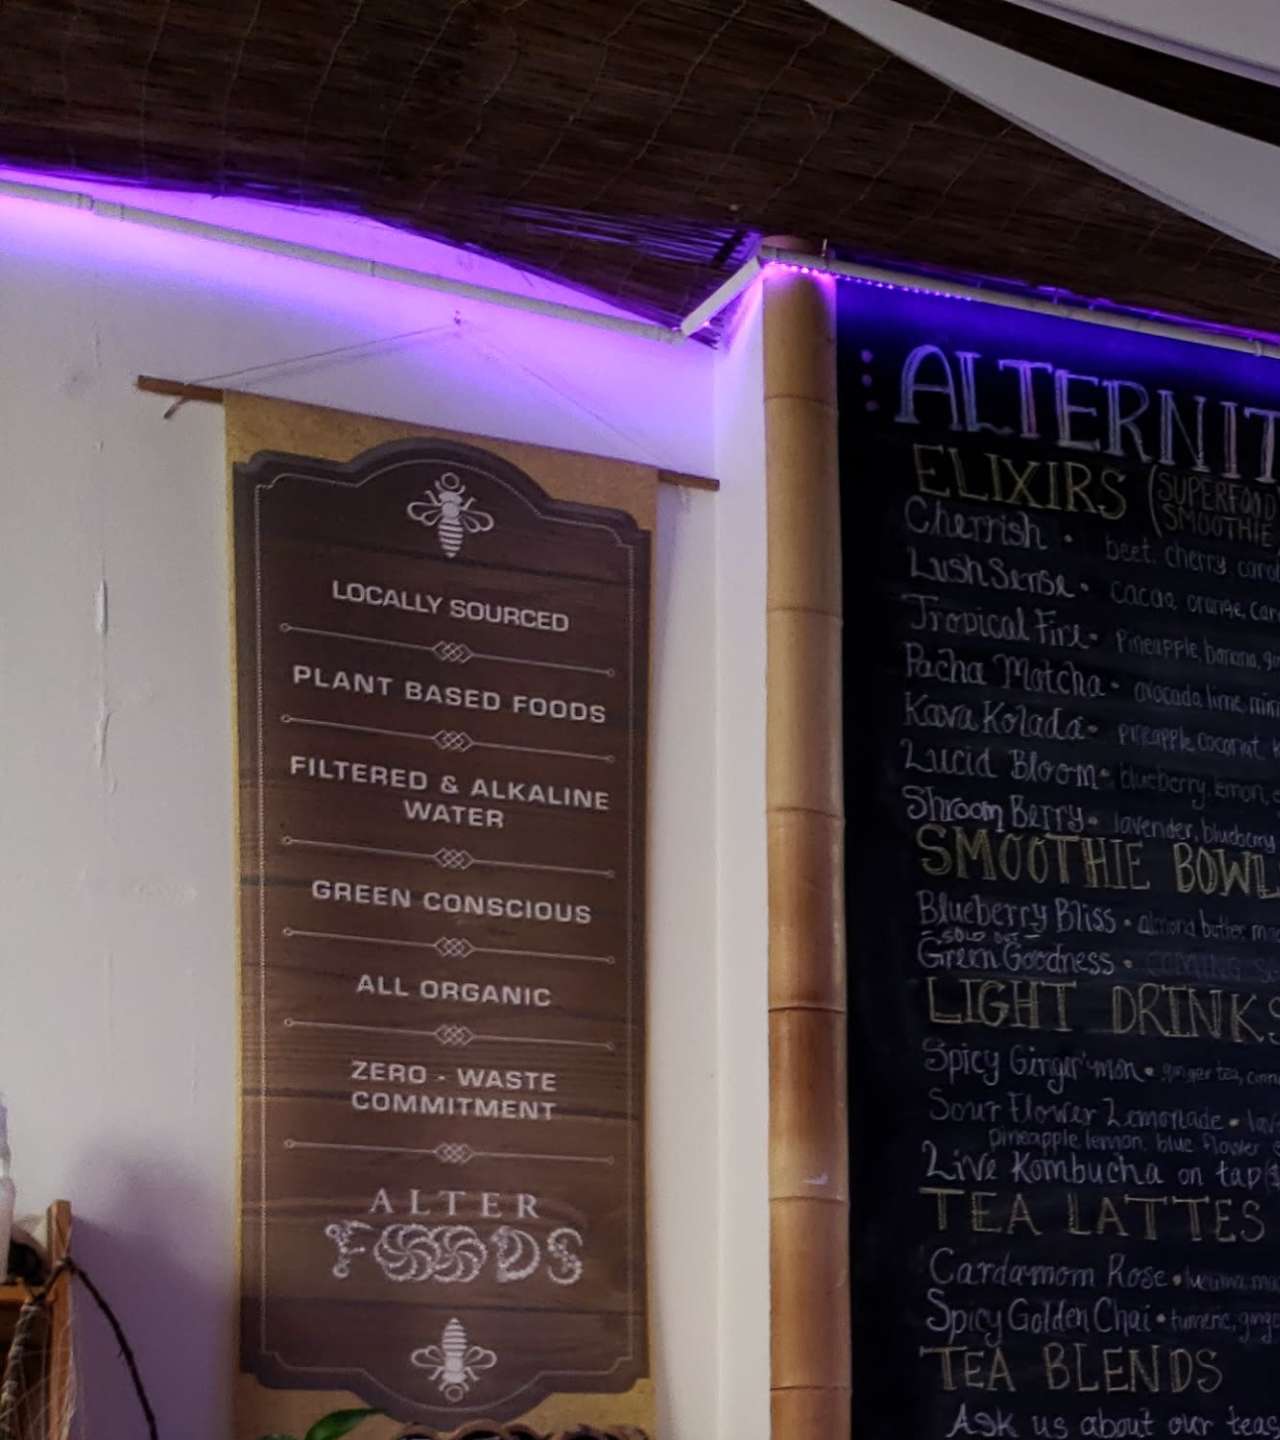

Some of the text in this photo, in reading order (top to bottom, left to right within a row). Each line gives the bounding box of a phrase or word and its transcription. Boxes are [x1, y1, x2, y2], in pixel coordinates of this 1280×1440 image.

[911, 443, 1128, 520] ELIXIRS
[904, 495, 1048, 550] Cherrish
[333, 580, 569, 632] LOCALLY SOURCED
[900, 593, 1029, 641] Tropical
[1034, 608, 1089, 648] Fire
[293, 665, 606, 723] PLANT BASED FOODS
[903, 641, 988, 686] Pacha
[992, 653, 1106, 697] Matcha
[902, 689, 980, 731] Kava
[982, 701, 1085, 740] Kolada
[290, 756, 609, 810] FILTERED & ALKALINE
[899, 737, 999, 779] Lucid
[1008, 750, 1100, 790] Bloom
[404, 800, 504, 828] WATER
[900, 784, 1006, 833] Shroom
[1008, 794, 1084, 833] Berry
[914, 823, 1150, 890] SMOOTHIE
[312, 880, 592, 924] GREEN CONSCIOUS
[913, 888, 1048, 934] Blueberry
[1053, 896, 1117, 934] Bliss
[917, 935, 1001, 970] Green
[1002, 941, 1115, 976] Goodness
[357, 974, 552, 1008] ALL ORGANIC
[927, 977, 1078, 1032] LIGHT
[351, 1060, 427, 1085] ZERO
[457, 1067, 557, 1092] WASTE
[921, 1037, 1000, 1086] Spicy
[351, 1091, 557, 1121] COMMITMENT
[927, 1087, 1002, 1123] Sour
[1004, 1090, 1098, 1126] Flower
[1101, 1097, 1224, 1131] Lemonade
[921, 1139, 1000, 1182] Live
[1011, 1150, 1166, 1185] Kombucha
[1177, 1166, 1205, 1187] on
[1216, 1160, 1262, 1190] tap
[369, 1188, 541, 1219] ALTER
[917, 1186, 1043, 1237] TEA
[1065, 1192, 1266, 1243] LATTES
[325, 1220, 584, 1285] FOODS
[928, 1247, 1096, 1288] Cardamom
[1106, 1252, 1168, 1290] Rose
[925, 1287, 1003, 1348] Spicy
[1007, 1297, 1090, 1335] Golden
[1094, 1295, 1152, 1336] Chai
[918, 1345, 1017, 1392] TEA
[1042, 1342, 1223, 1394] BLENDS
[945, 1400, 1021, 1439] Ask
[1030, 1414, 1069, 1439] us
[1080, 1406, 1153, 1440] about
[1168, 1414, 1215, 1438] our
